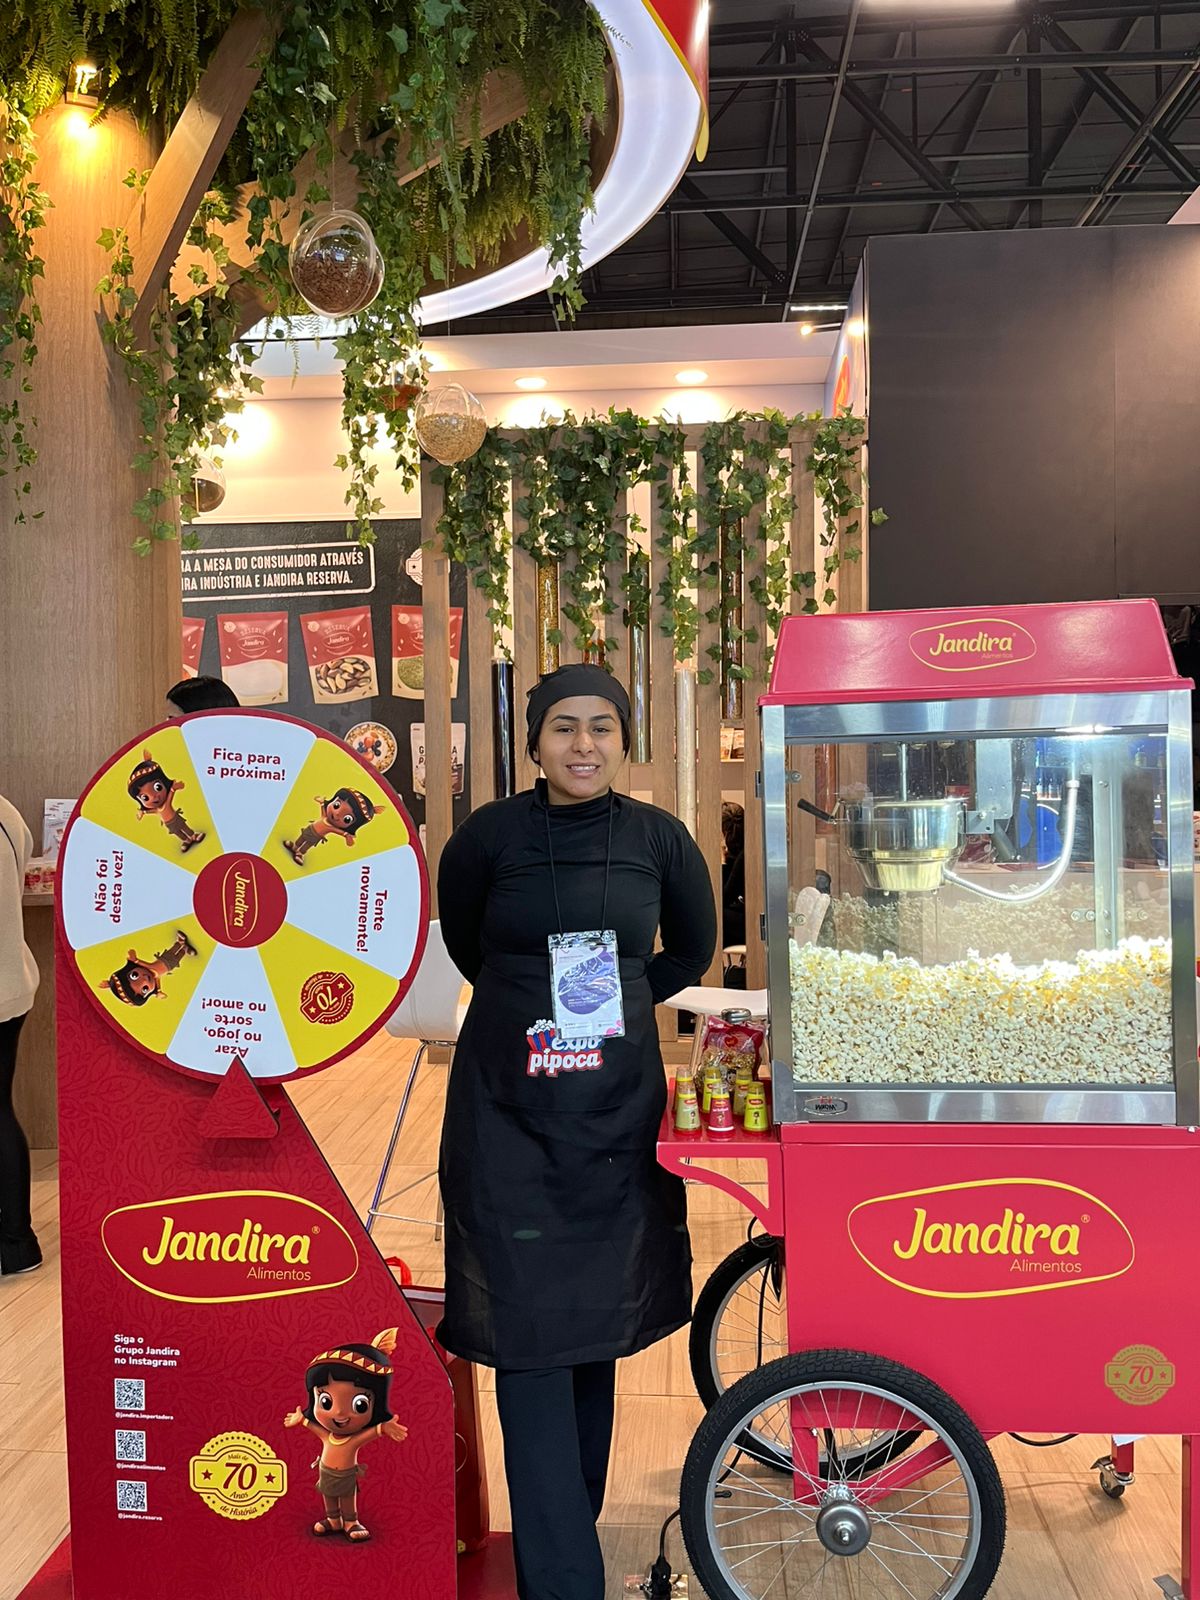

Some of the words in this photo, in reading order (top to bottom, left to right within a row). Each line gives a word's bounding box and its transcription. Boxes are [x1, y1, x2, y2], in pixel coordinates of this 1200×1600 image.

[193, 558, 201, 572] A
[203, 557, 232, 572] MESA
[235, 556, 248, 570] DO
[251, 553, 317, 569] CONSUMIDOR
[320, 547, 364, 567] ATRAVÉS
[201, 573, 252, 590] INDÚSTRIA
[255, 574, 260, 587] E
[263, 572, 303, 588] JANDIRA
[306, 570, 353, 586] RESERVA.
[930, 632, 1013, 656] Jandira
[213, 747, 242, 762] Fica
[247, 754, 281, 765] para
[207, 766, 215, 775] a
[220, 764, 286, 781] próxima!
[96, 859, 108, 878] foi
[112, 850, 124, 878] vez!
[94, 883, 107, 912] Não
[109, 883, 122, 924] desta
[234, 871, 250, 927] Jandira
[356, 866, 371, 952] novamente!
[373, 890, 388, 931] Tente
[202, 998, 244, 1009] amor!
[249, 1002, 266, 1012] no
[317, 985, 338, 1010] 70
[214, 1014, 253, 1026] sorte
[204, 1027, 241, 1043] jogo,
[244, 1032, 261, 1042] no
[215, 1045, 249, 1059] Azar
[529, 1050, 602, 1074] pipoca
[142, 1216, 311, 1265] Jandira
[893, 1208, 1081, 1260] Jandira
[247, 1267, 311, 1281] Alimentos
[1009, 1259, 1082, 1273] Alimentos
[114, 1334, 135, 1345] Siga
[114, 1345, 144, 1356] Grupo
[145, 1346, 180, 1356] Jandira
[114, 1357, 127, 1365] no
[128, 1356, 177, 1368] Instagram
[1128, 1365, 1154, 1385] 70
[222, 1462, 257, 1490] 70
